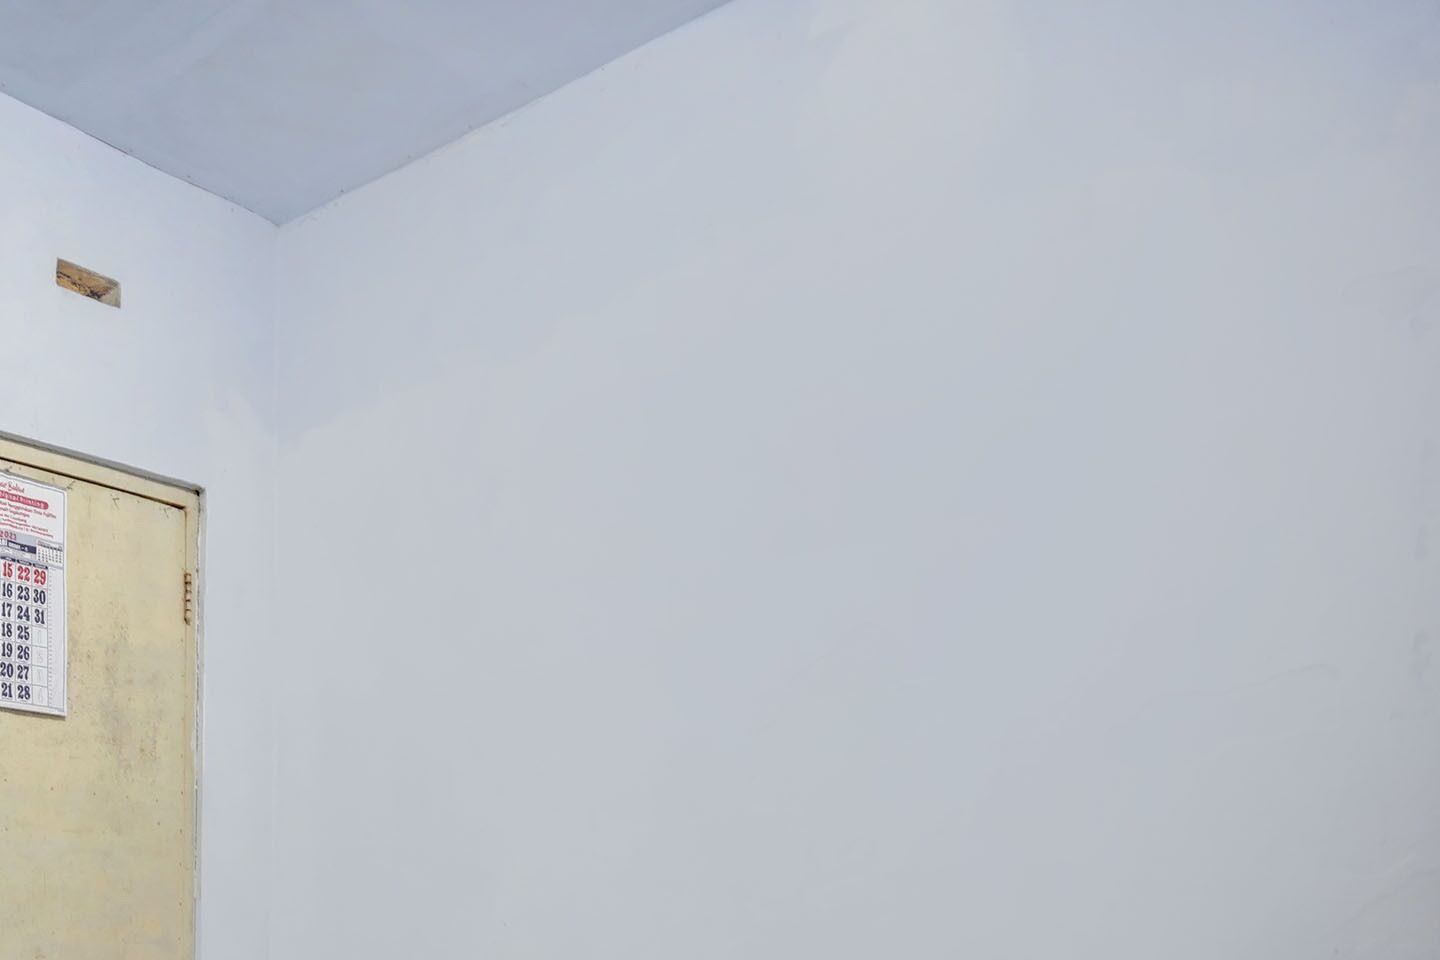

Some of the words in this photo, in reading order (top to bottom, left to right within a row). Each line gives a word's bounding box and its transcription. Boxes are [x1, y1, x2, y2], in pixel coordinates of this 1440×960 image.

[3, 561, 13, 578] 15
[17, 565, 30, 582] 22
[33, 569, 46, 586] 29
[2, 582, 13, 598] 16
[17, 585, 30, 601] 23
[33, 589, 46, 605] 30
[2, 602, 12, 618] 17
[17, 605, 30, 621] 24
[34, 609, 45, 625] 31
[2, 622, 12, 638] 18
[17, 625, 30, 640] 25
[2, 642, 13, 658] 19
[17, 645, 30, 660] 26
[0, 661, 14, 678] 20
[17, 665, 29, 681] 27
[1, 682, 13, 698] 21
[17, 685, 31, 700] 28
